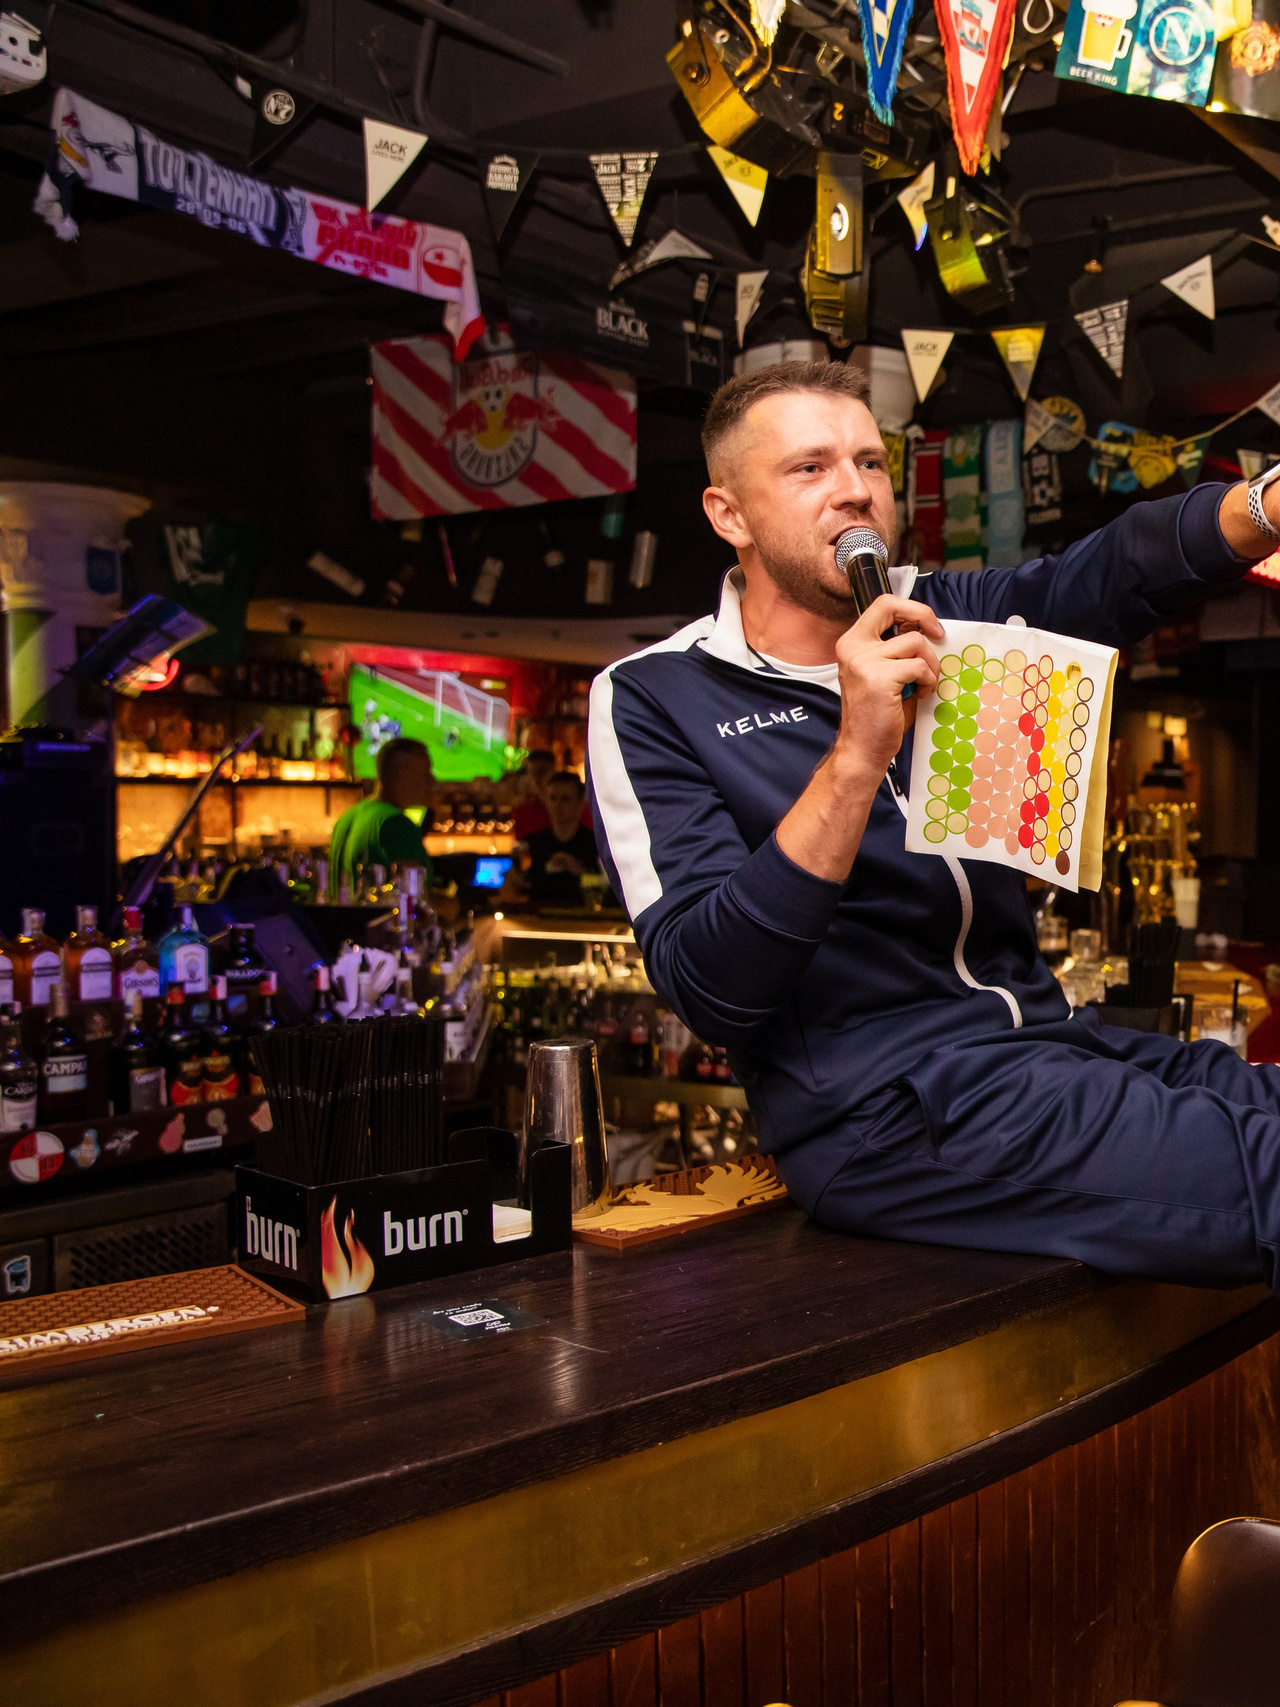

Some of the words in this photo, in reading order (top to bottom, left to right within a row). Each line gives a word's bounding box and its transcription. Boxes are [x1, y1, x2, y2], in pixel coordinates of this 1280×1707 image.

[1069, 65, 1094, 80] BEER
[1094, 72, 1118, 87] KING
[374, 139, 408, 157] JACK
[596, 306, 649, 341] BLACK
[913, 342, 938, 352] JACK
[716, 706, 809, 738] KELME
[245, 1195, 298, 1271] burn
[383, 1209, 463, 1257] burn
